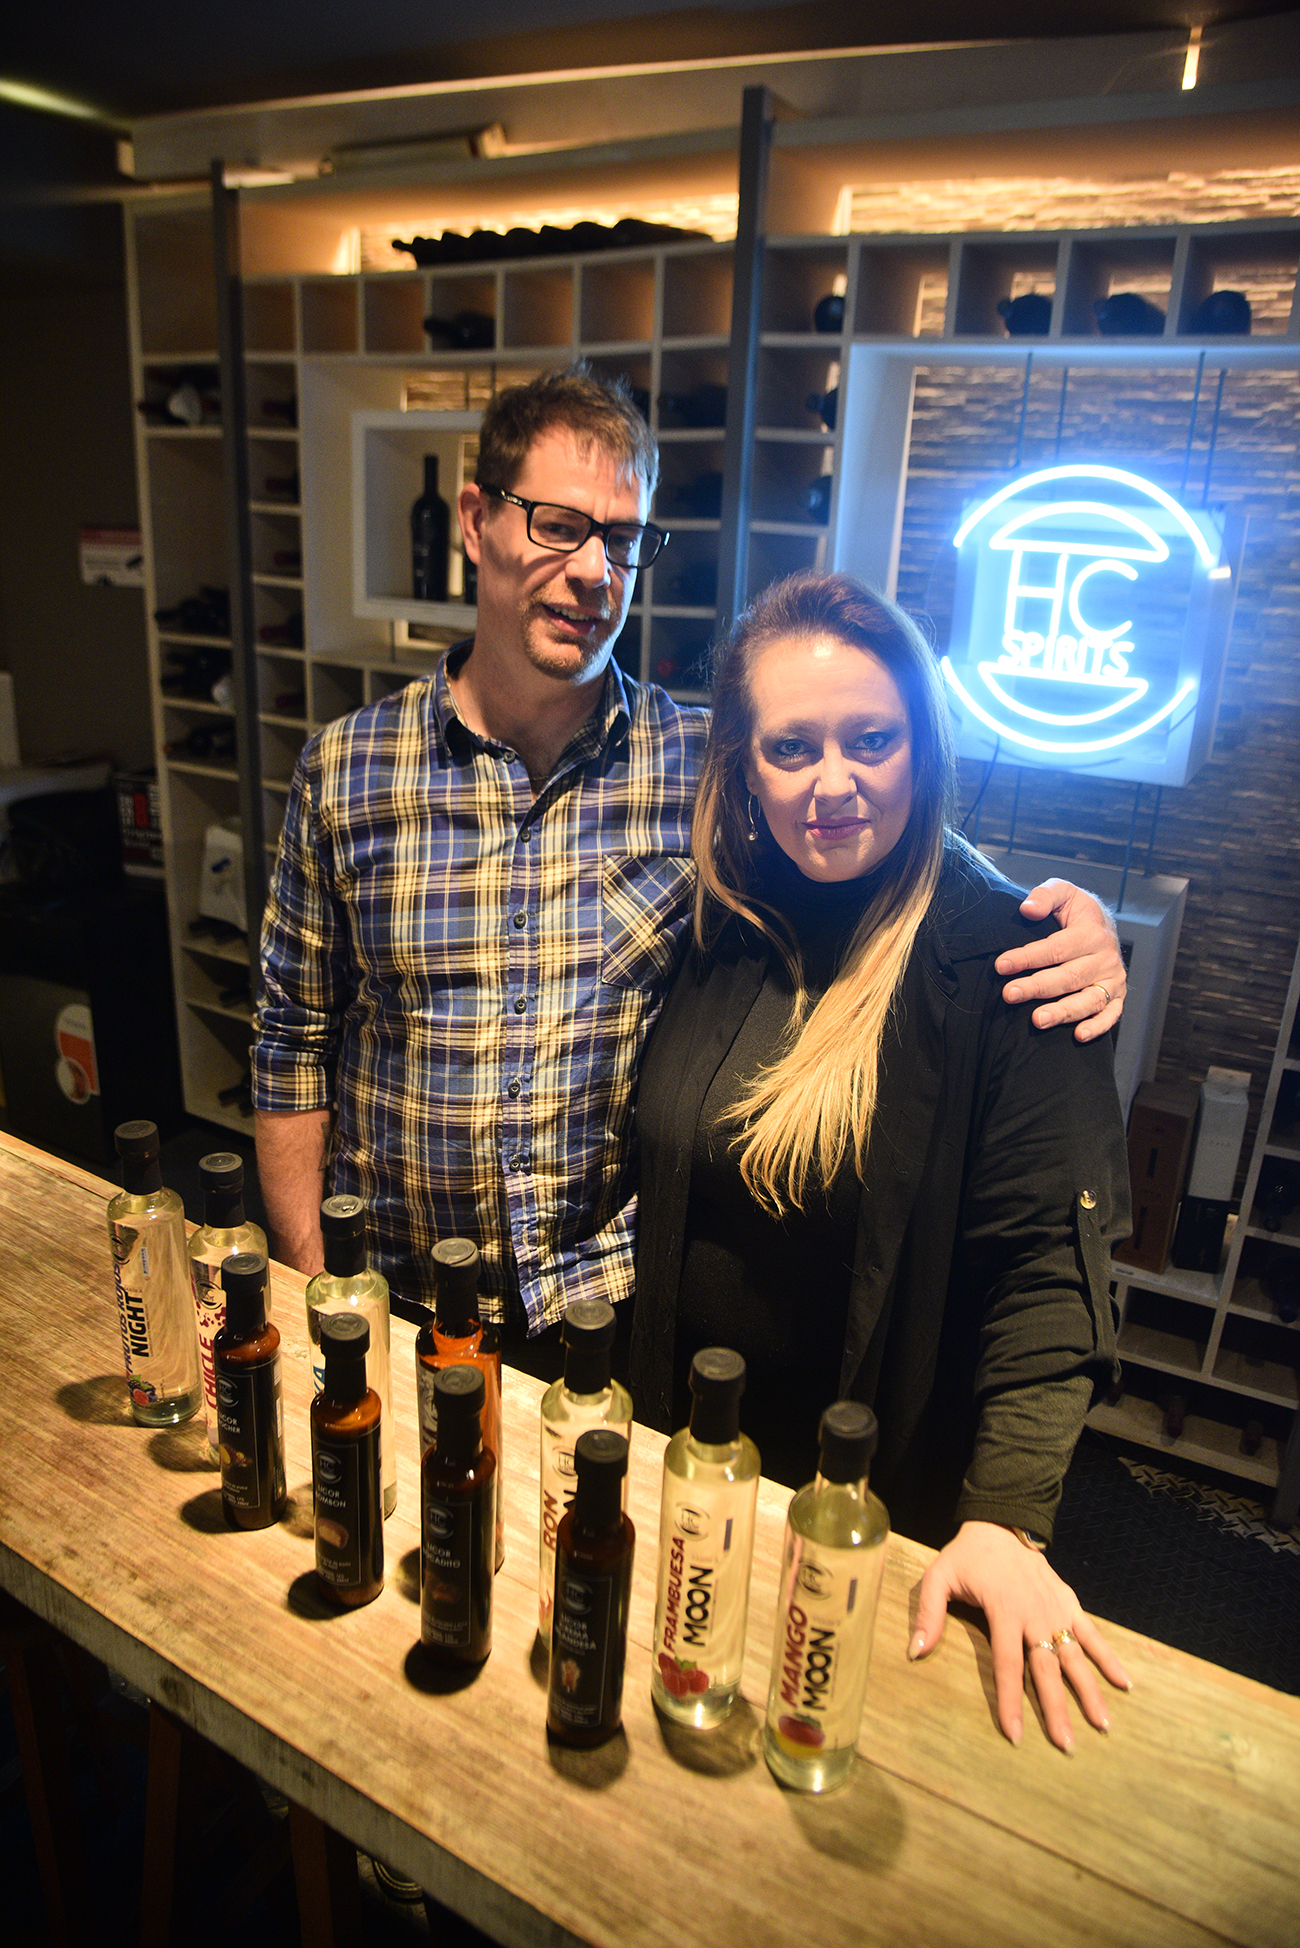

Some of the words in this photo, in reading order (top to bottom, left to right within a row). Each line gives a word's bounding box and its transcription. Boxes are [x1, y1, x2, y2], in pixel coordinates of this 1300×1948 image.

[1004, 550, 1139, 641] HC
[998, 630, 1135, 677] SPIRITS
[113, 1263, 127, 1313] ROJOS
[119, 1313, 133, 1374] FRUTOS
[124, 1291, 150, 1358] NIGHT
[199, 1332, 217, 1411] CHICLE
[317, 1483, 341, 1499] LICOR
[543, 1489, 558, 1552] RON
[426, 1541, 452, 1559] LICOR
[664, 1536, 686, 1653] FRAMBUESA
[682, 1565, 714, 1647] MOON
[780, 1605, 808, 1709] MANGO
[802, 1627, 836, 1711] MOON
